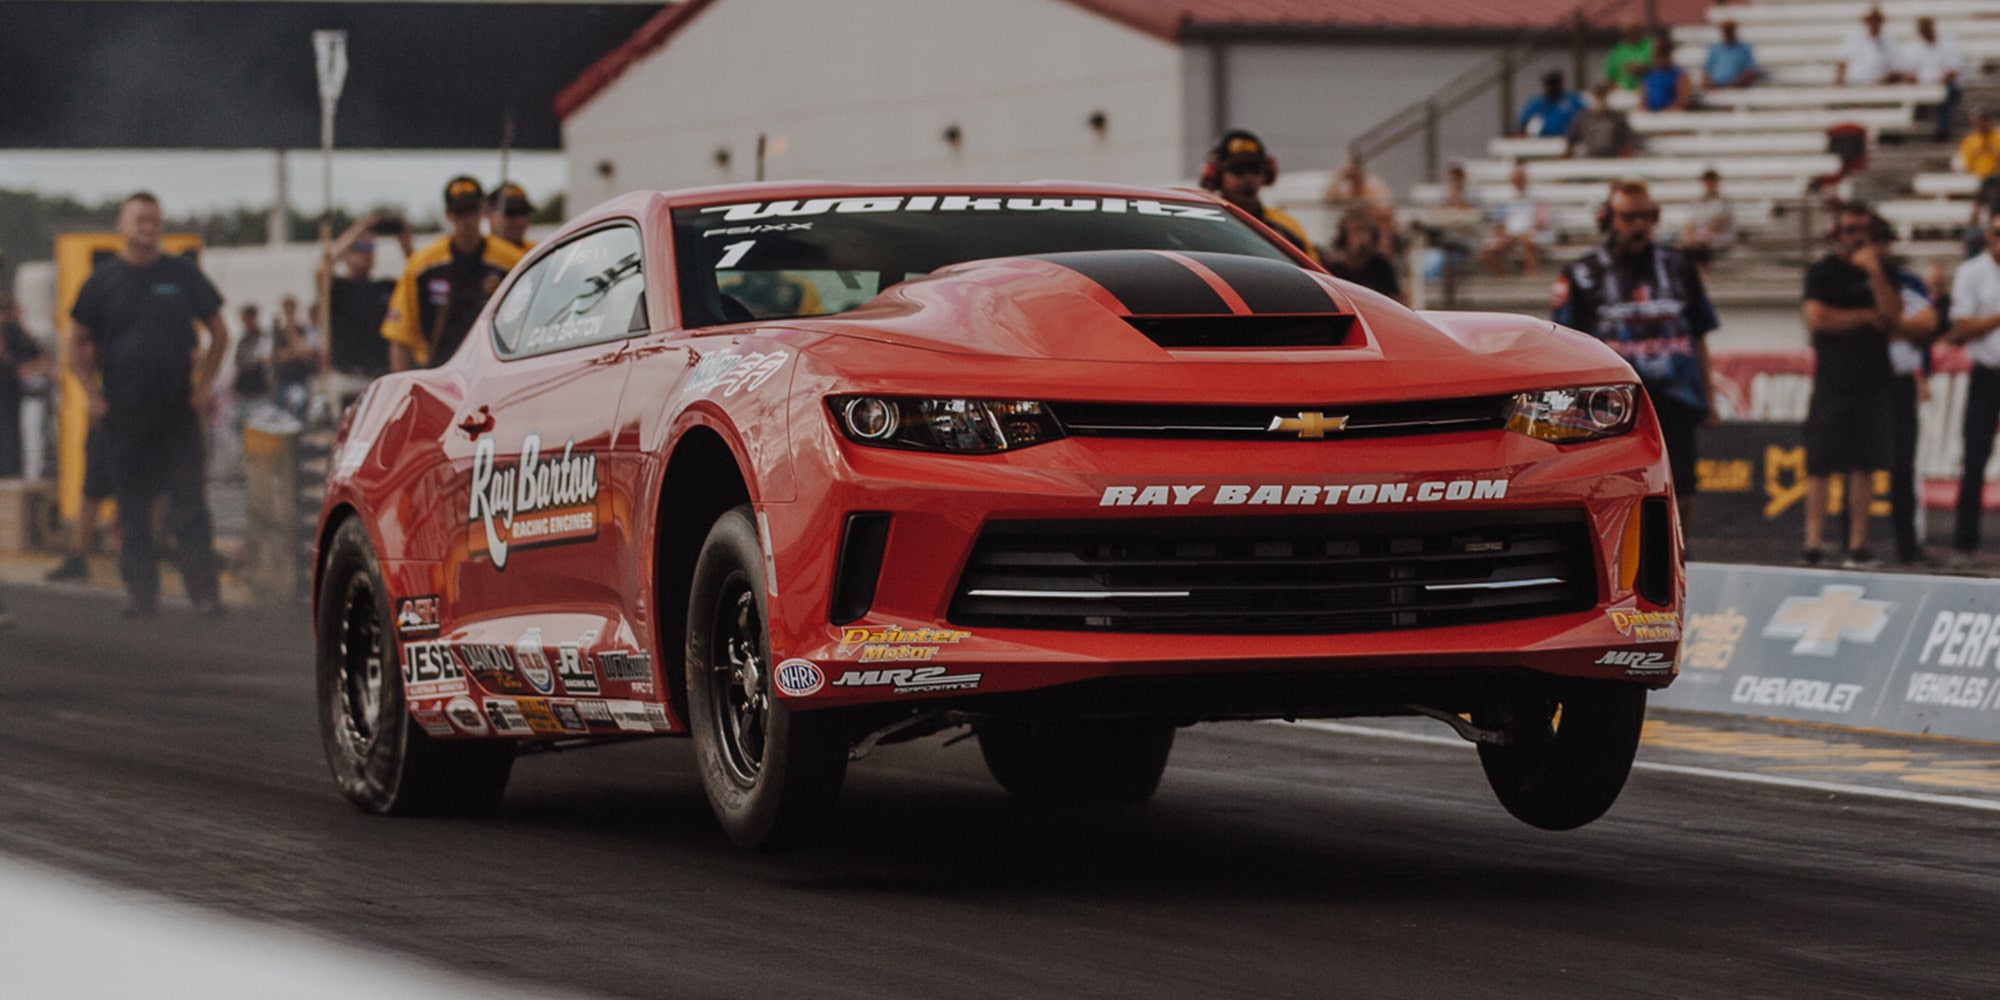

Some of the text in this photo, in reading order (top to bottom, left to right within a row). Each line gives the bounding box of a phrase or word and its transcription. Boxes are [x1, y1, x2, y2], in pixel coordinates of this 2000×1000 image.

[715, 240, 757, 269] 1
[469, 433, 598, 568] Ray Barton
[1100, 479, 1509, 506] RAY BARTON.COM
[512, 511, 593, 539] RACING ENGINES
[1918, 610, 2000, 668] PERF
[403, 643, 466, 683] JESEL
[859, 645, 939, 662] Motor
[1594, 651, 1673, 669] MR2
[780, 666, 817, 689] NHRA
[832, 667, 981, 687] MR2
[1731, 674, 1863, 714] CHEVROLET
